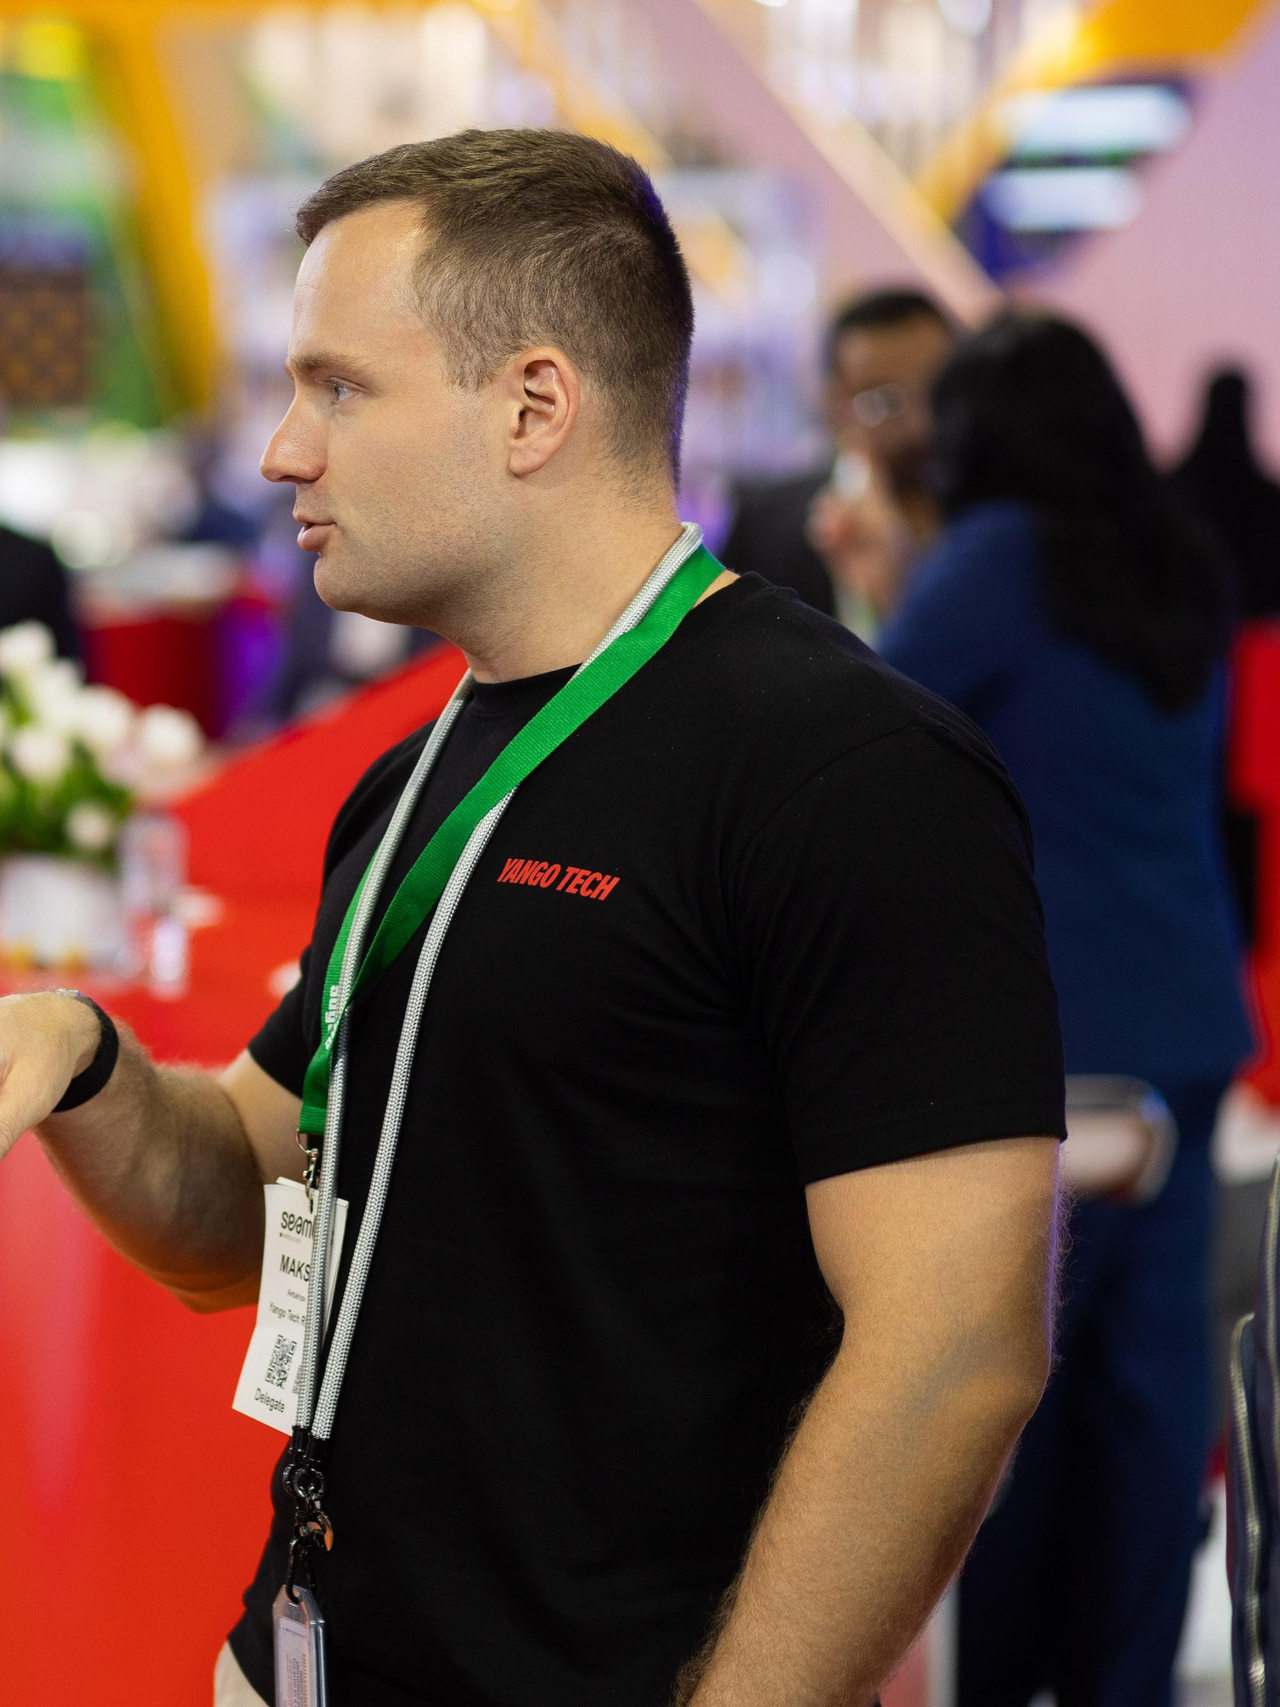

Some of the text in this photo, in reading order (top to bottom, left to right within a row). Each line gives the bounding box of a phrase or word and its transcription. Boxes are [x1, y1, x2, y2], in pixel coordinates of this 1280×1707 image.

[497, 858, 620, 901] YANGO TECH
[254, 1388, 285, 1413] Delegate
